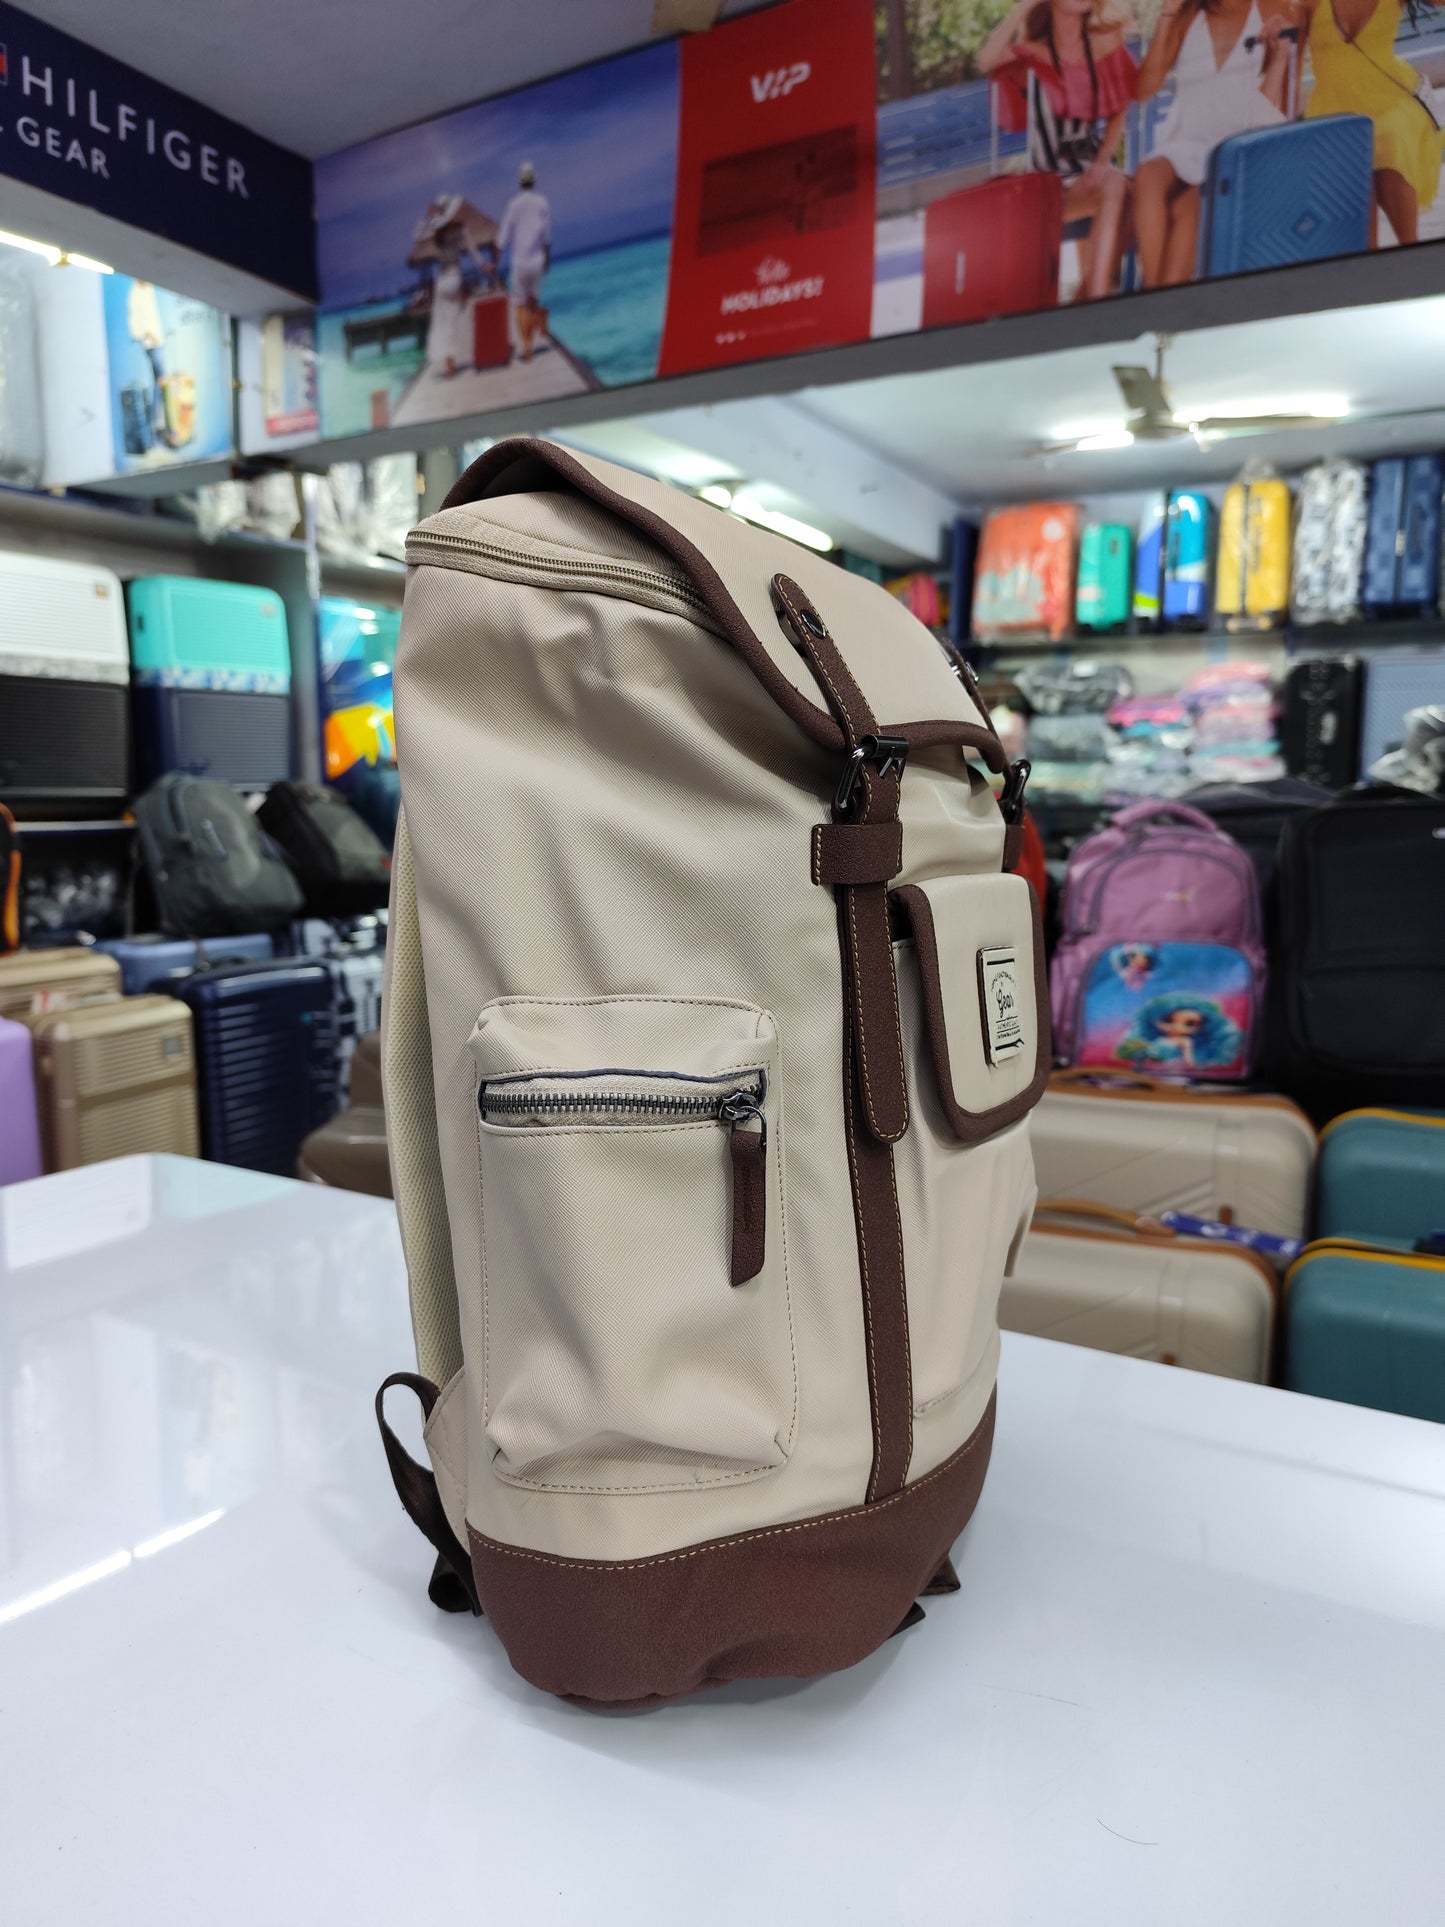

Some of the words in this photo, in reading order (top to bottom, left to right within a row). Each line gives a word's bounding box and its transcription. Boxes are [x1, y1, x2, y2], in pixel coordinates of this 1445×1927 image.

[750, 62, 811, 103] VIP
[16, 117, 110, 179] GEAR
[22, 56, 249, 199] HILFIGER
